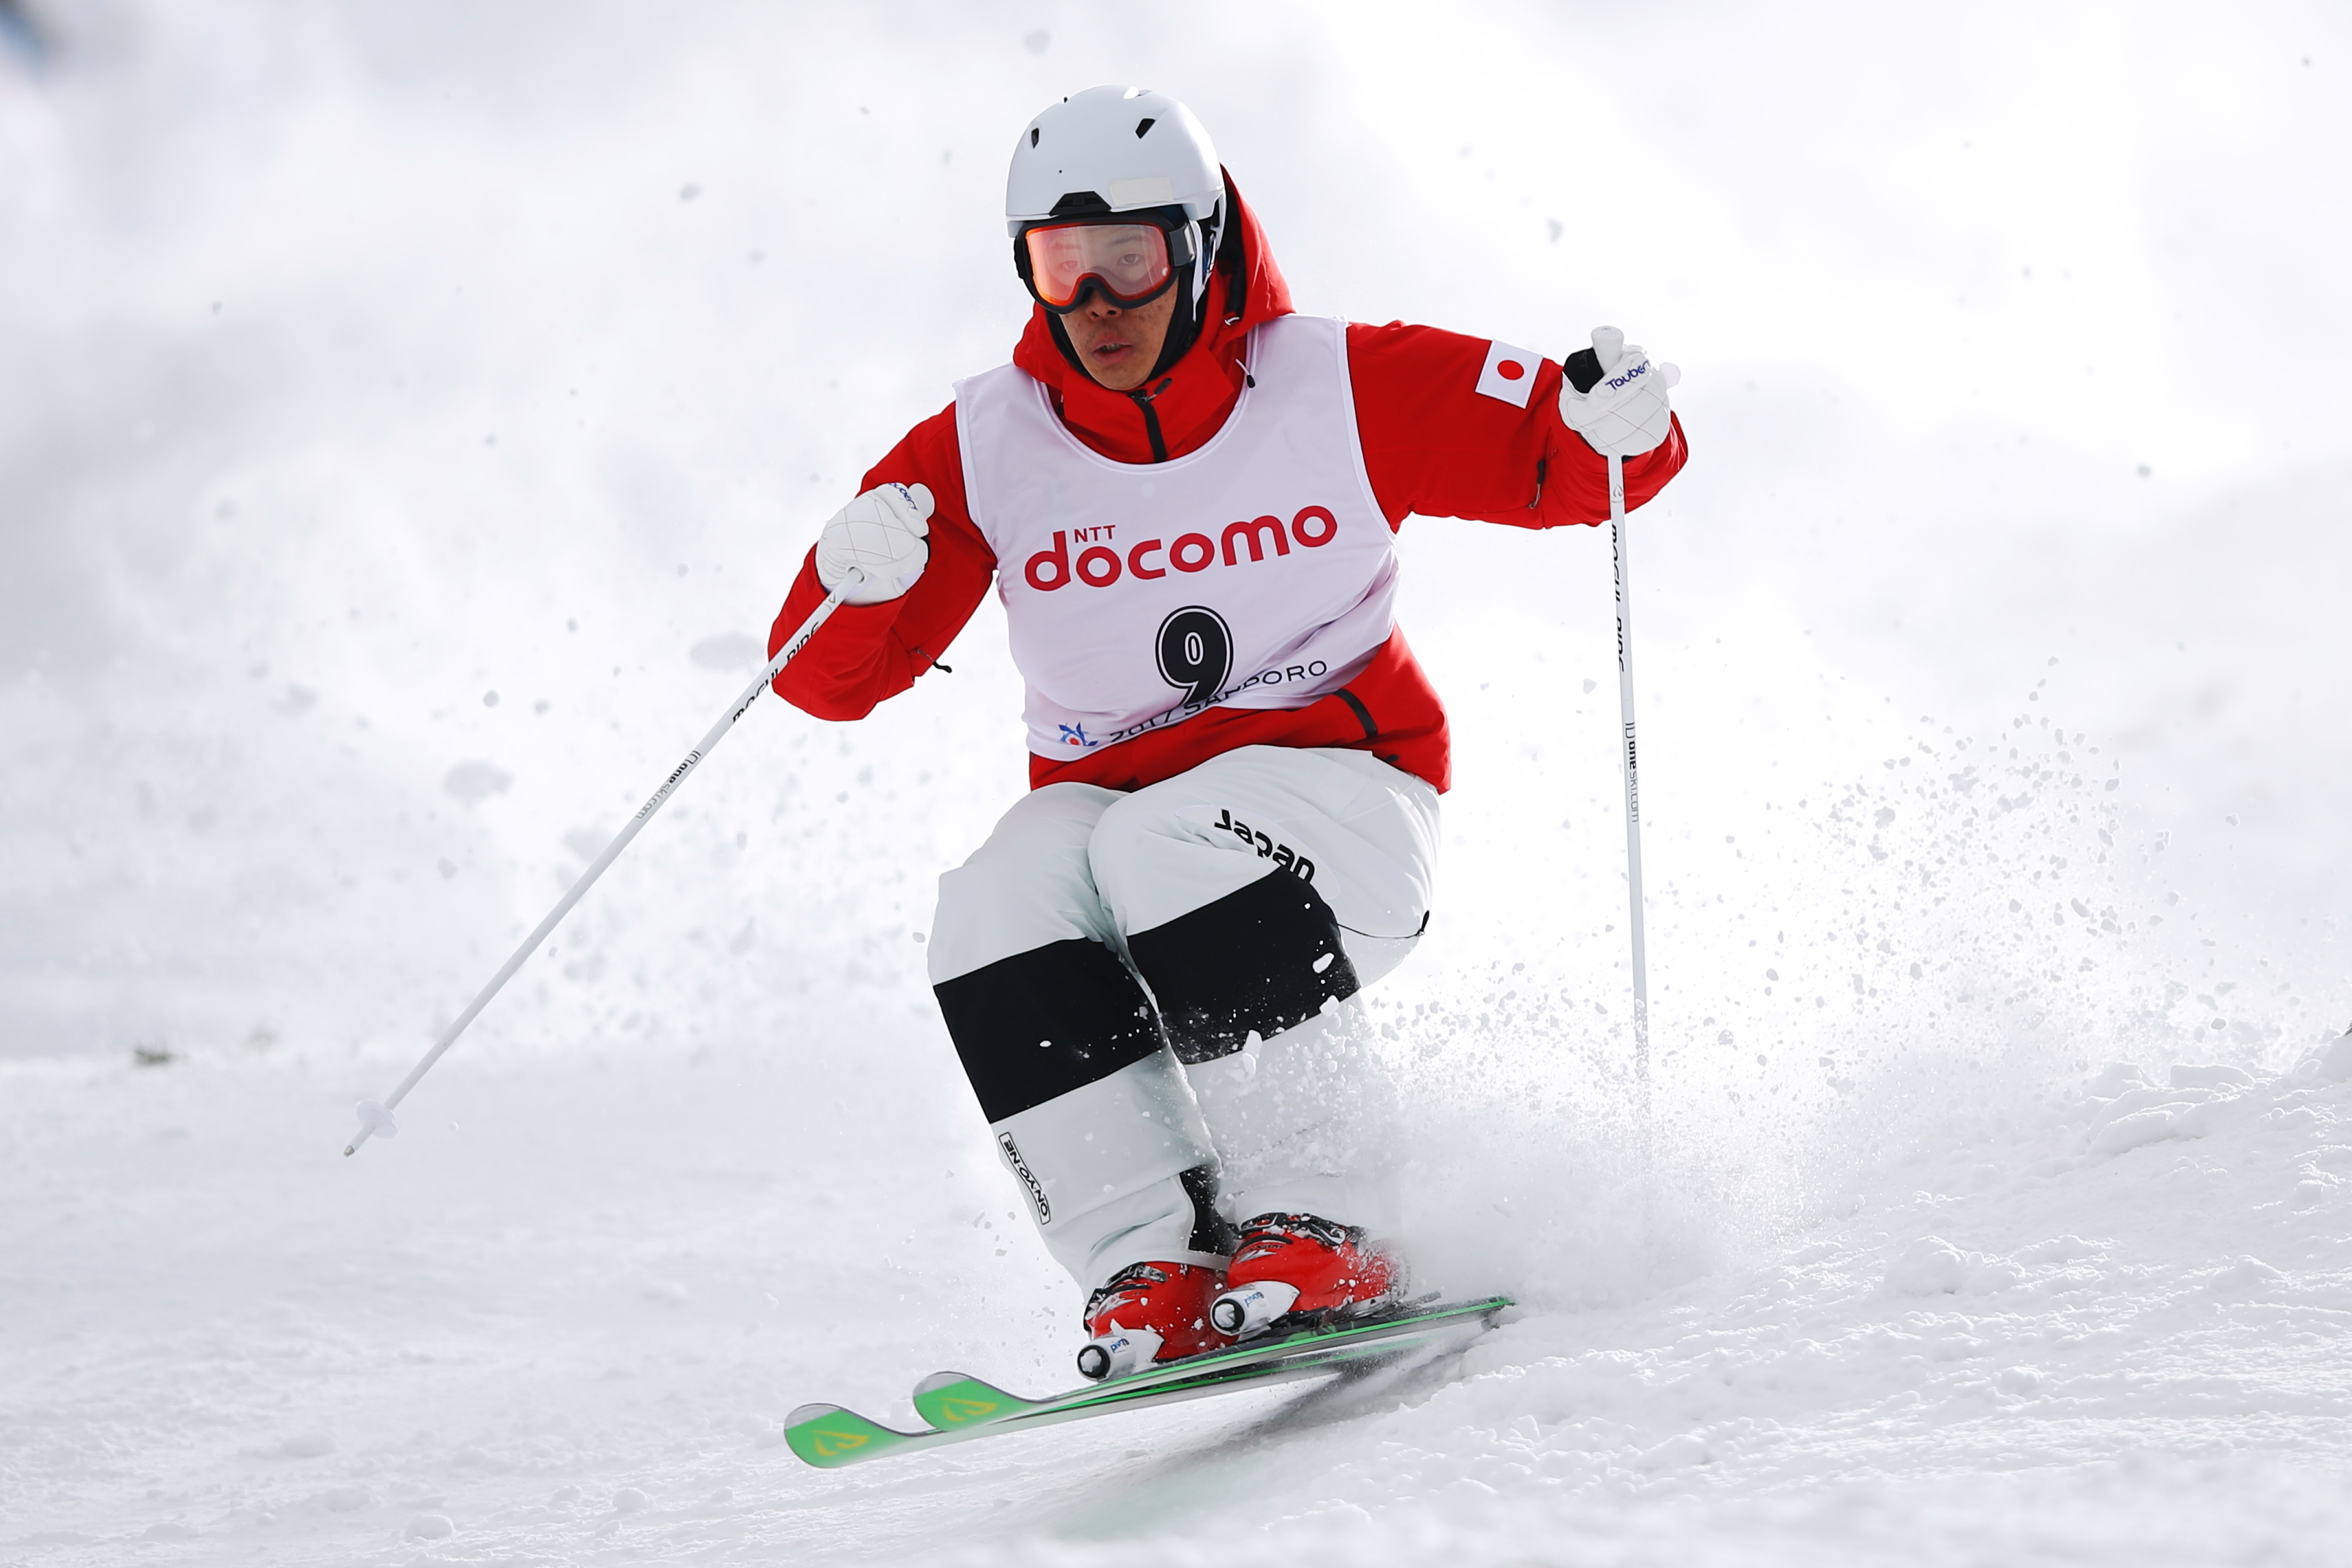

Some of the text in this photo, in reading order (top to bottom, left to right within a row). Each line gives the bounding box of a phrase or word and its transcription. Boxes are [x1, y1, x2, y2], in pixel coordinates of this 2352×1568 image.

[1024, 505, 1338, 591] docomo
[1074, 525, 1116, 544] NTT
[1155, 605, 1234, 707] 9
[1214, 809, 1315, 884] Japan
